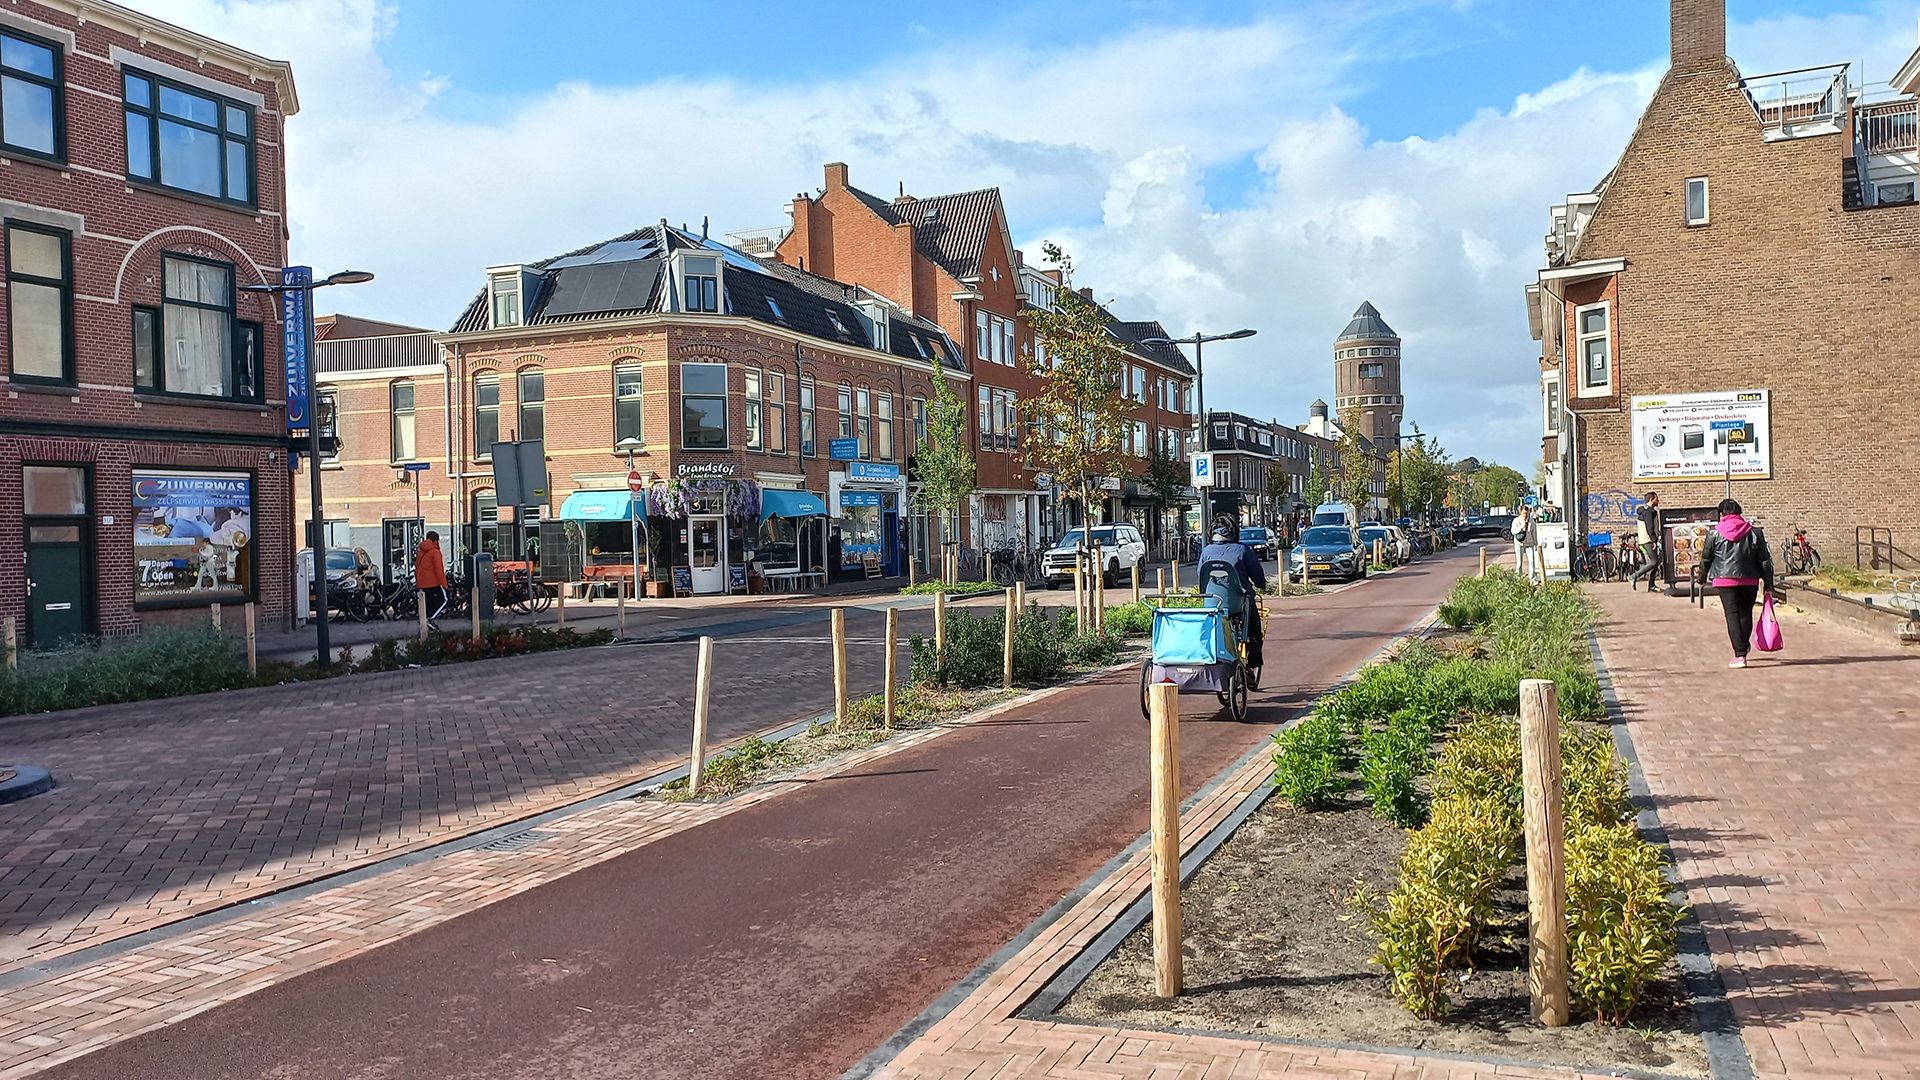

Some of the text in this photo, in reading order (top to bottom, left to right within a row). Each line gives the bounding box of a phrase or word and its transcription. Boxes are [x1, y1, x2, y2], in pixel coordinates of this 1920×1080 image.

[285, 271, 300, 397] ZUIVERWAS
[678, 462, 735, 476] Brandstof
[157, 480, 246, 493] ZUIVERWAS
[157, 498, 246, 506] ZELFSERVICE WASSERETTE
[691, 496, 721, 512] 314
[139, 560, 152, 582] 7
[151, 560, 174, 569] Dagen
[151, 571, 174, 583] Open
